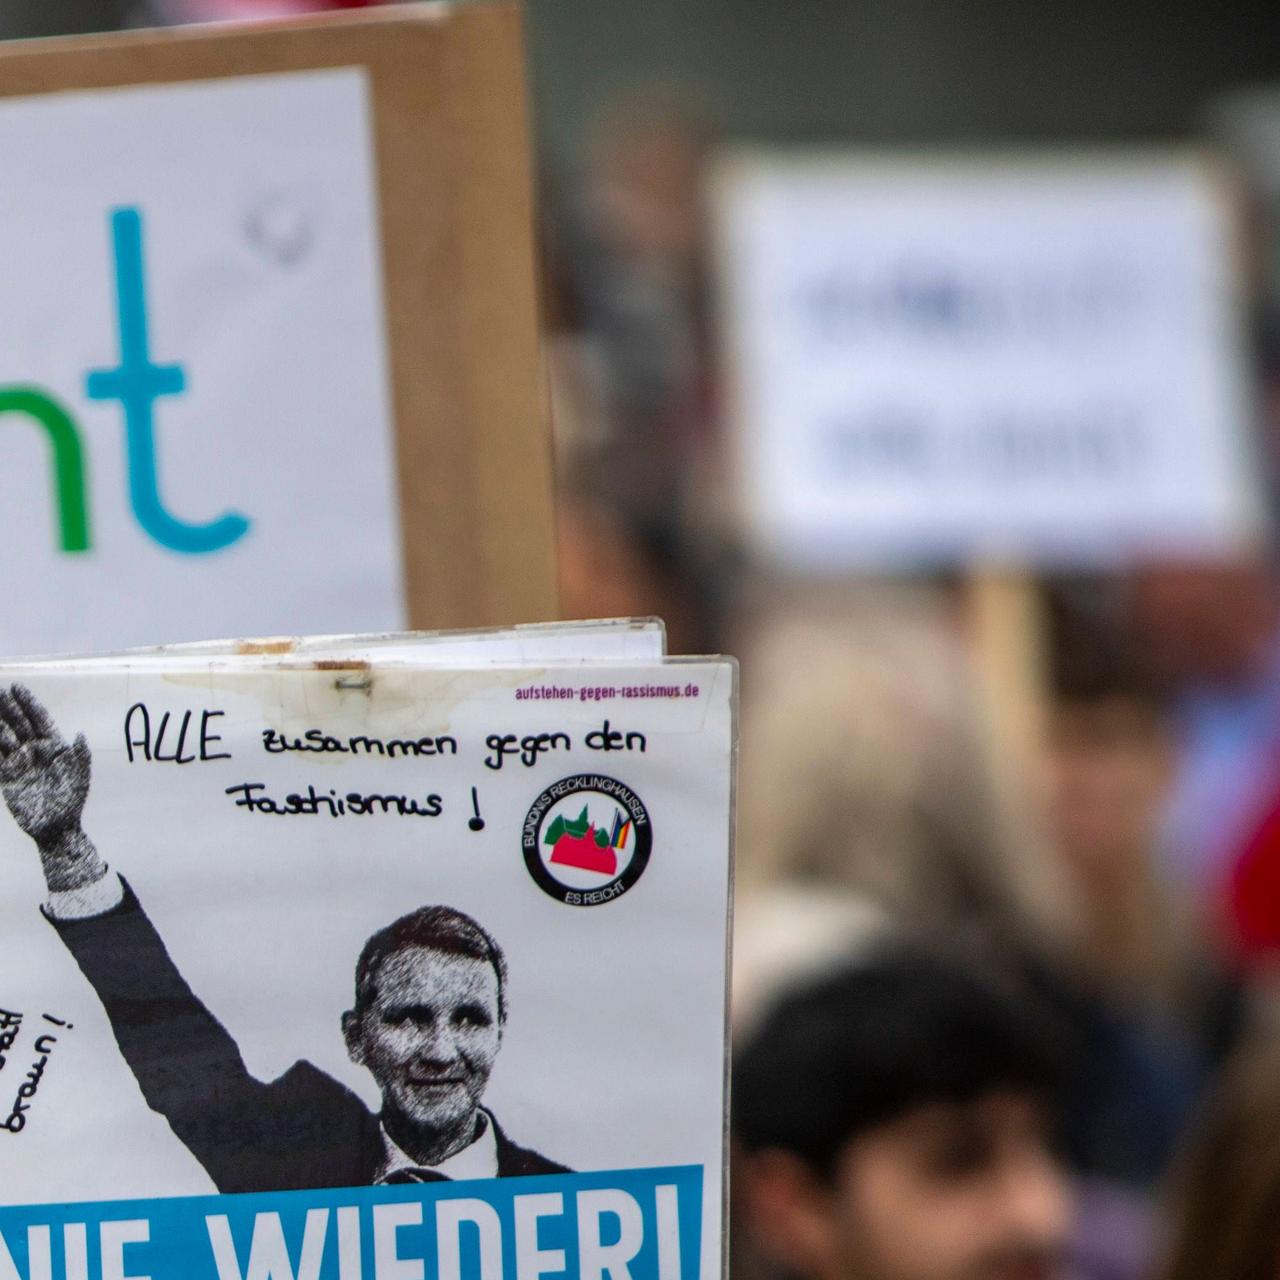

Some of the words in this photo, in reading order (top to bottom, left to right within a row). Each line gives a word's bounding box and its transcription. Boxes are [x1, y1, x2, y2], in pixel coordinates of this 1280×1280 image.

[515, 683, 700, 702] aufstehen-gegen-rassismus.de
[123, 703, 232, 764] ALLE
[262, 728, 458, 759] zusammen
[484, 731, 572, 770] gegen
[584, 719, 647, 753] den
[550, 775, 648, 826] RECKLINGHAUSEN
[565, 890, 582, 905] ES
[584, 879, 626, 905] REICHT
